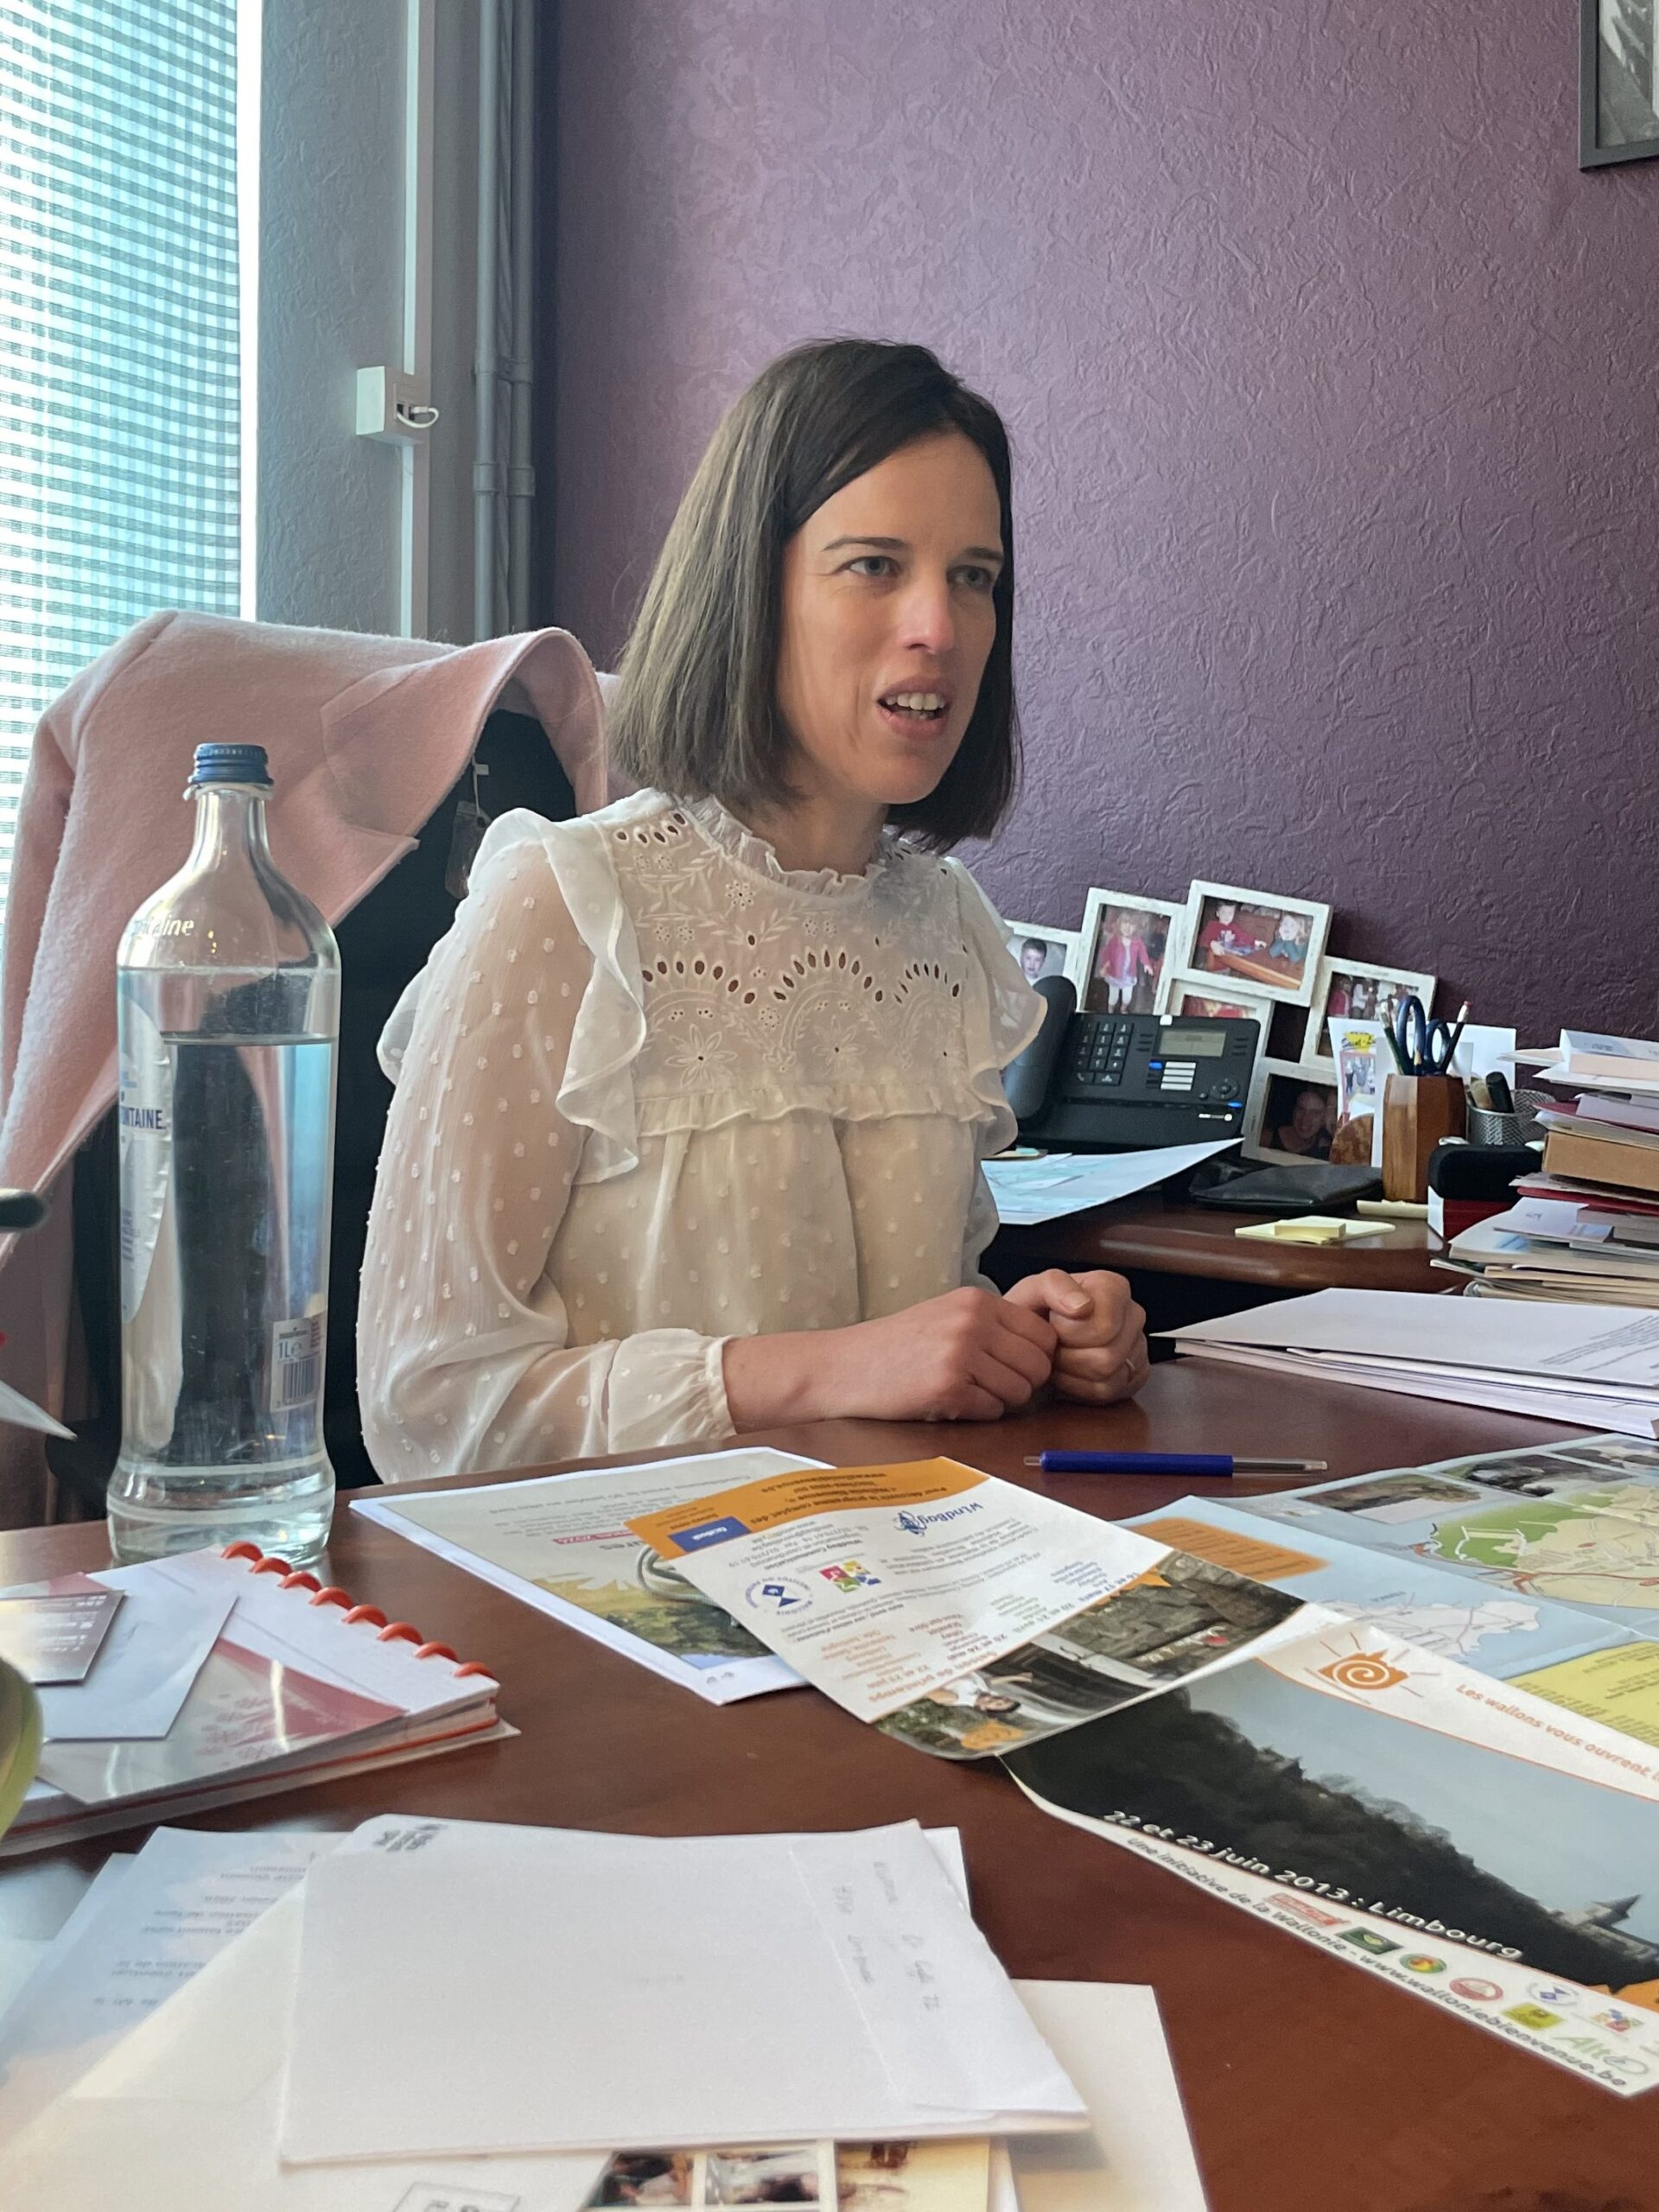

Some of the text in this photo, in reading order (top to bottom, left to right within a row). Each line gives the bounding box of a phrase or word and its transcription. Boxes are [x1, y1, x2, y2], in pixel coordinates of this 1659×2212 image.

[121, 1107, 167, 1130] NTAINE
[918, 1502, 983, 1527] WindBag
[1455, 1683, 1484, 1701] Les
[1484, 1696, 1544, 1728] wallons
[1545, 1725, 1584, 1747] vous
[1584, 1743, 1652, 1777] ouvrent
[1103, 1810, 1141, 1827] 22
[1142, 1823, 1175, 1839] et
[1176, 1834, 1216, 1853] 23
[1208, 1847, 1271, 1875] juin
[1274, 1869, 1351, 1901] 2013
[1368, 1901, 1523, 1960] Limbourg
[1127, 1836, 1158, 1857] Une
[1158, 1850, 1229, 1893] initiative
[1229, 1885, 1252, 1906] de
[1251, 1900, 1271, 1915] la
[1272, 1910, 1348, 1952] Wallonie
[1359, 1953, 1627, 2088] www.walloniebienvenue.be
